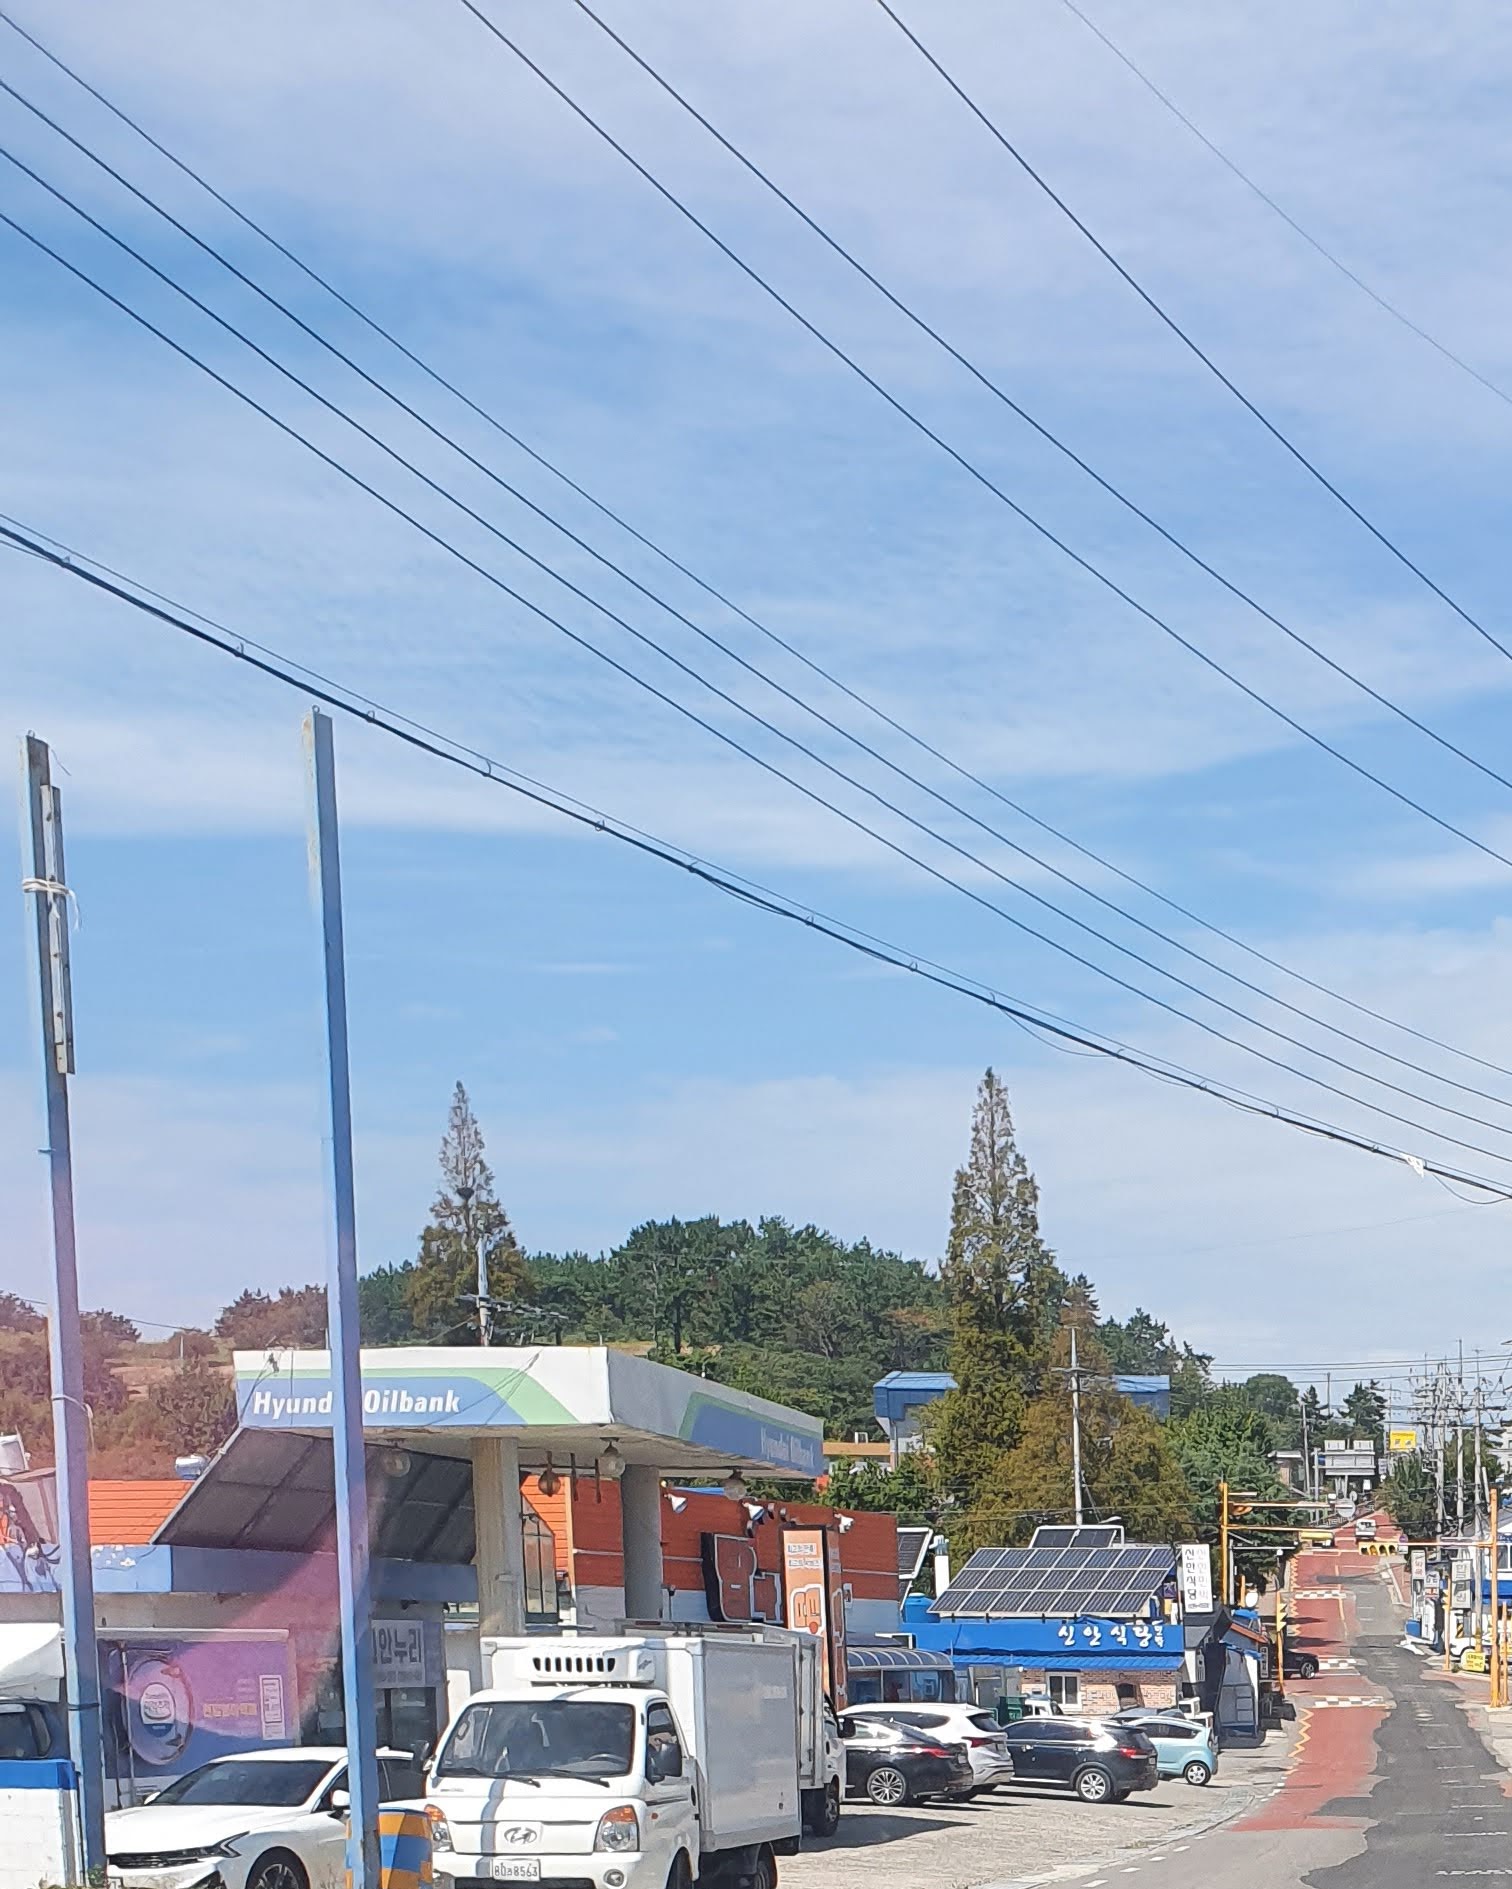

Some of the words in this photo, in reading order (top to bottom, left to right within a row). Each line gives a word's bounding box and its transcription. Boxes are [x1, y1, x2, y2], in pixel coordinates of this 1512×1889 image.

[253, 1391, 333, 1419] Hyund
[364, 1389, 460, 1414] Oilbank
[1058, 1625, 1152, 1648] 신안식당
